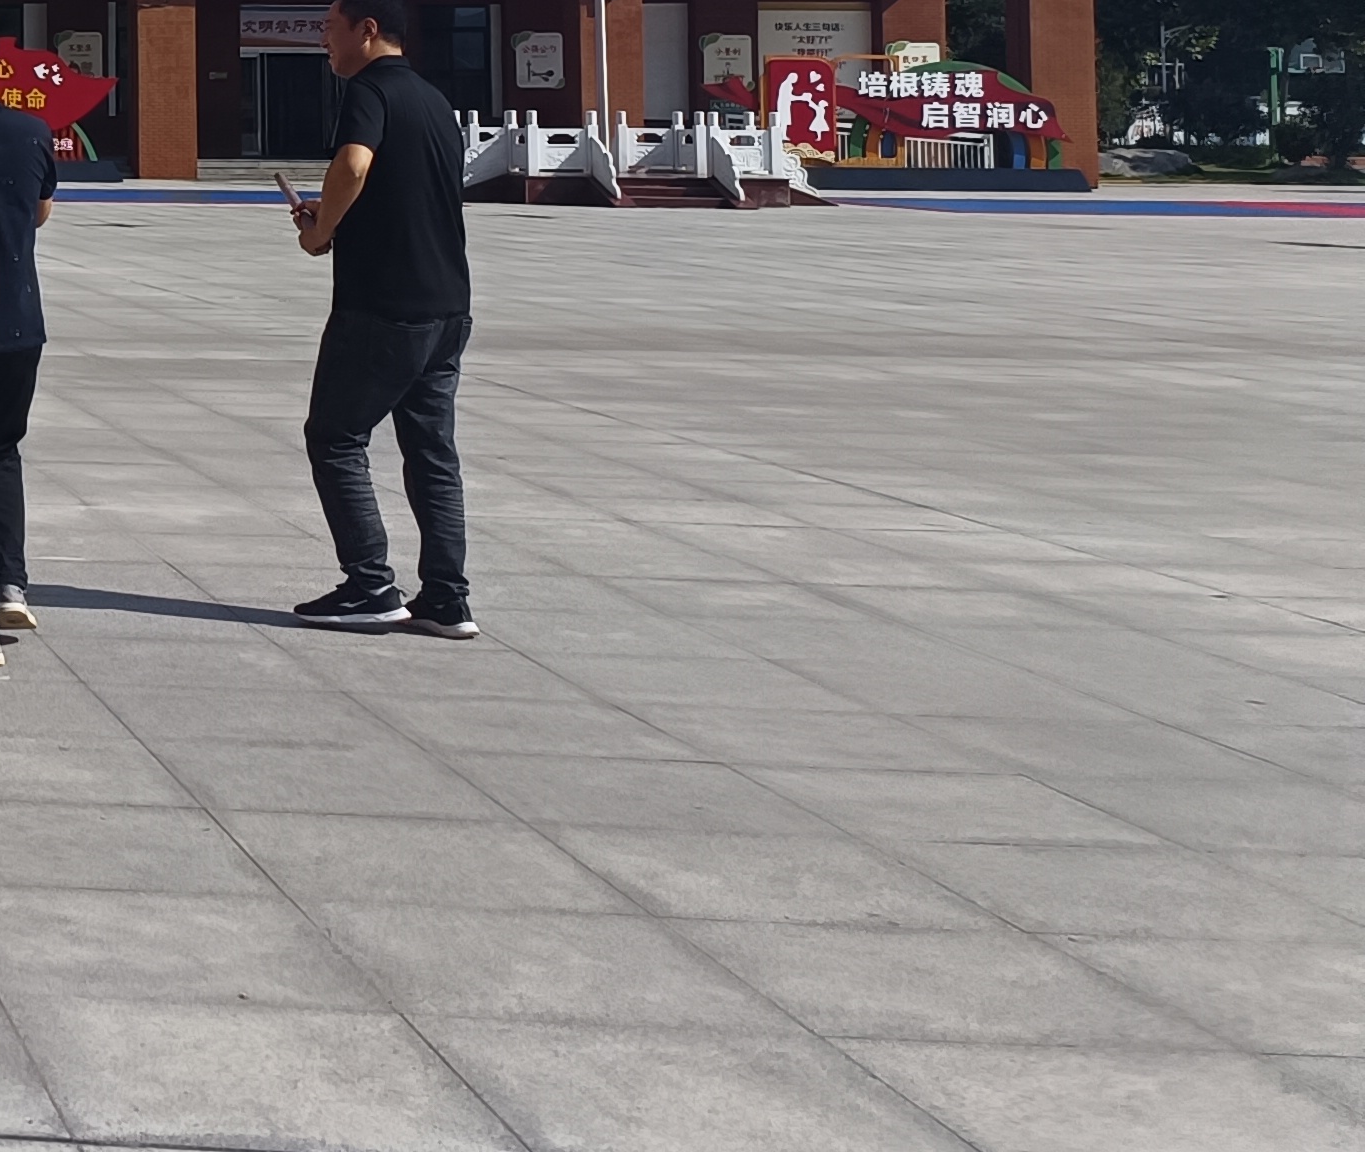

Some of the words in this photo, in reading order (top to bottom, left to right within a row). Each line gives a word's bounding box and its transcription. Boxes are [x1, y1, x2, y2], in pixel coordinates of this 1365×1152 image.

[858, 70, 984, 100] 培根铸魂
[921, 102, 1049, 129] 启智润心
